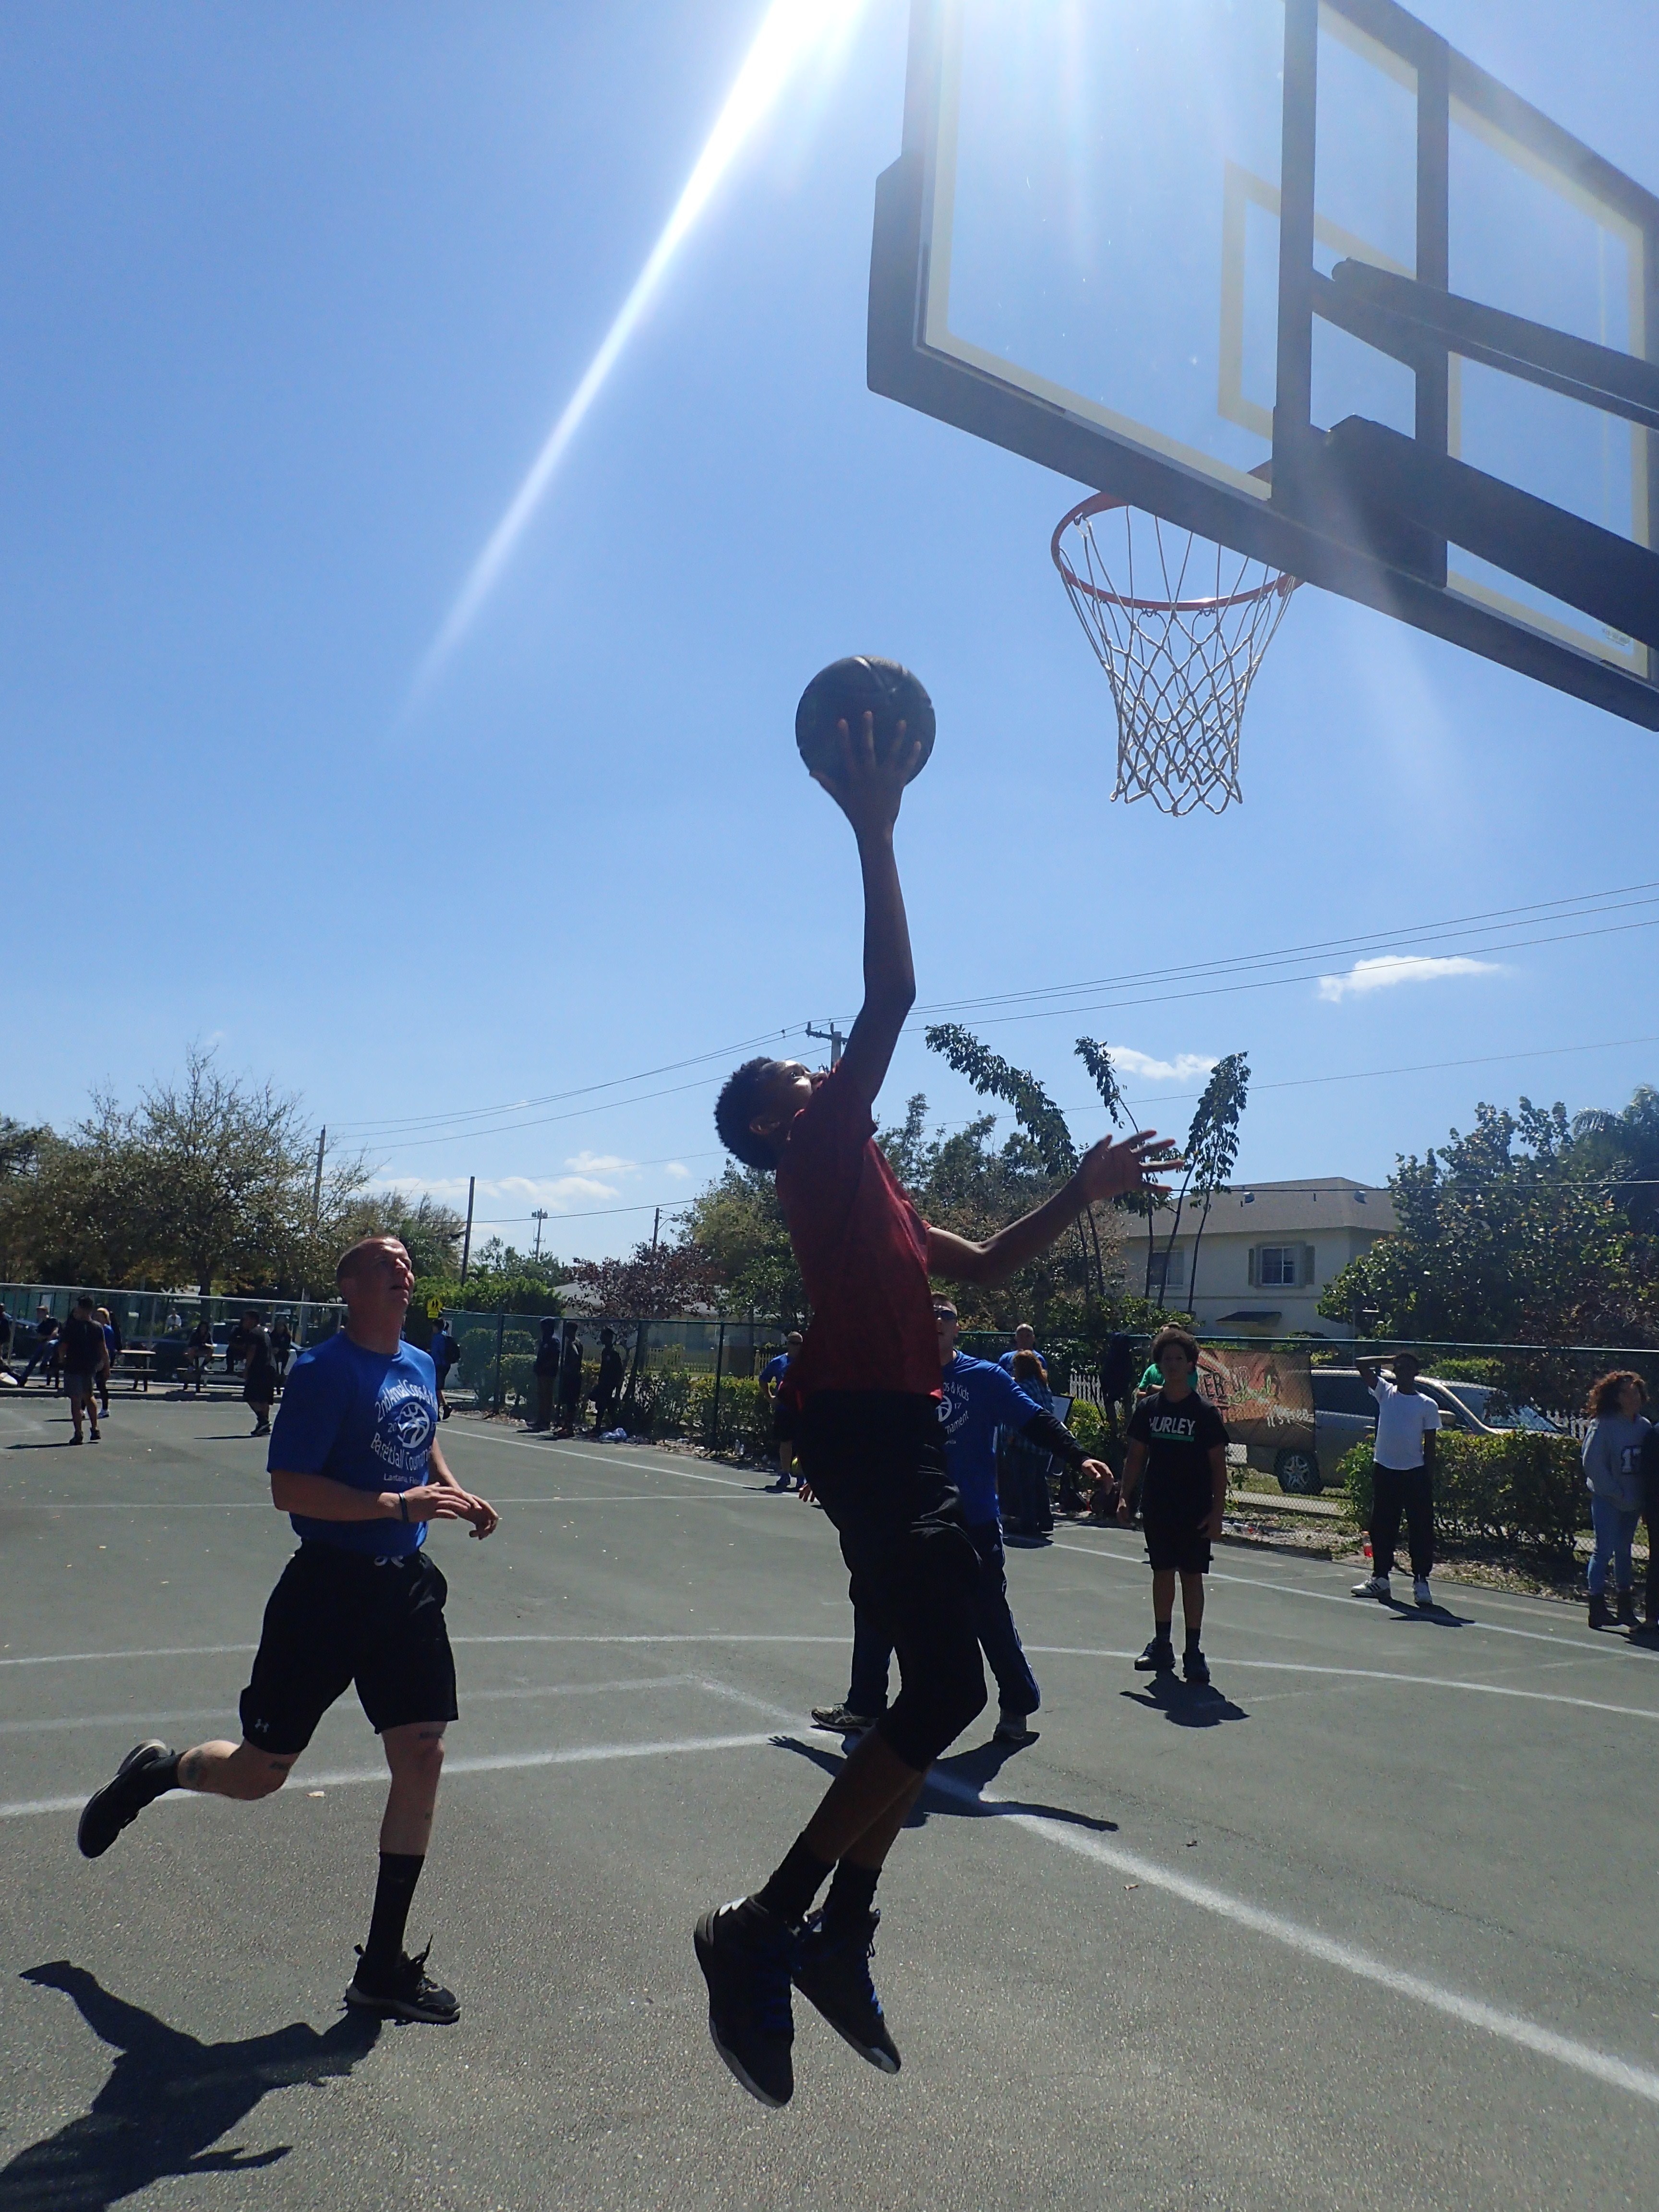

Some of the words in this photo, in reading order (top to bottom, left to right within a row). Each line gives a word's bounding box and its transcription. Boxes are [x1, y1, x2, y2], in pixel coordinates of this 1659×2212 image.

[950, 1382, 955, 1394] &
[957, 1384, 969, 1401] Kids
[945, 1410, 969, 1435] nament
